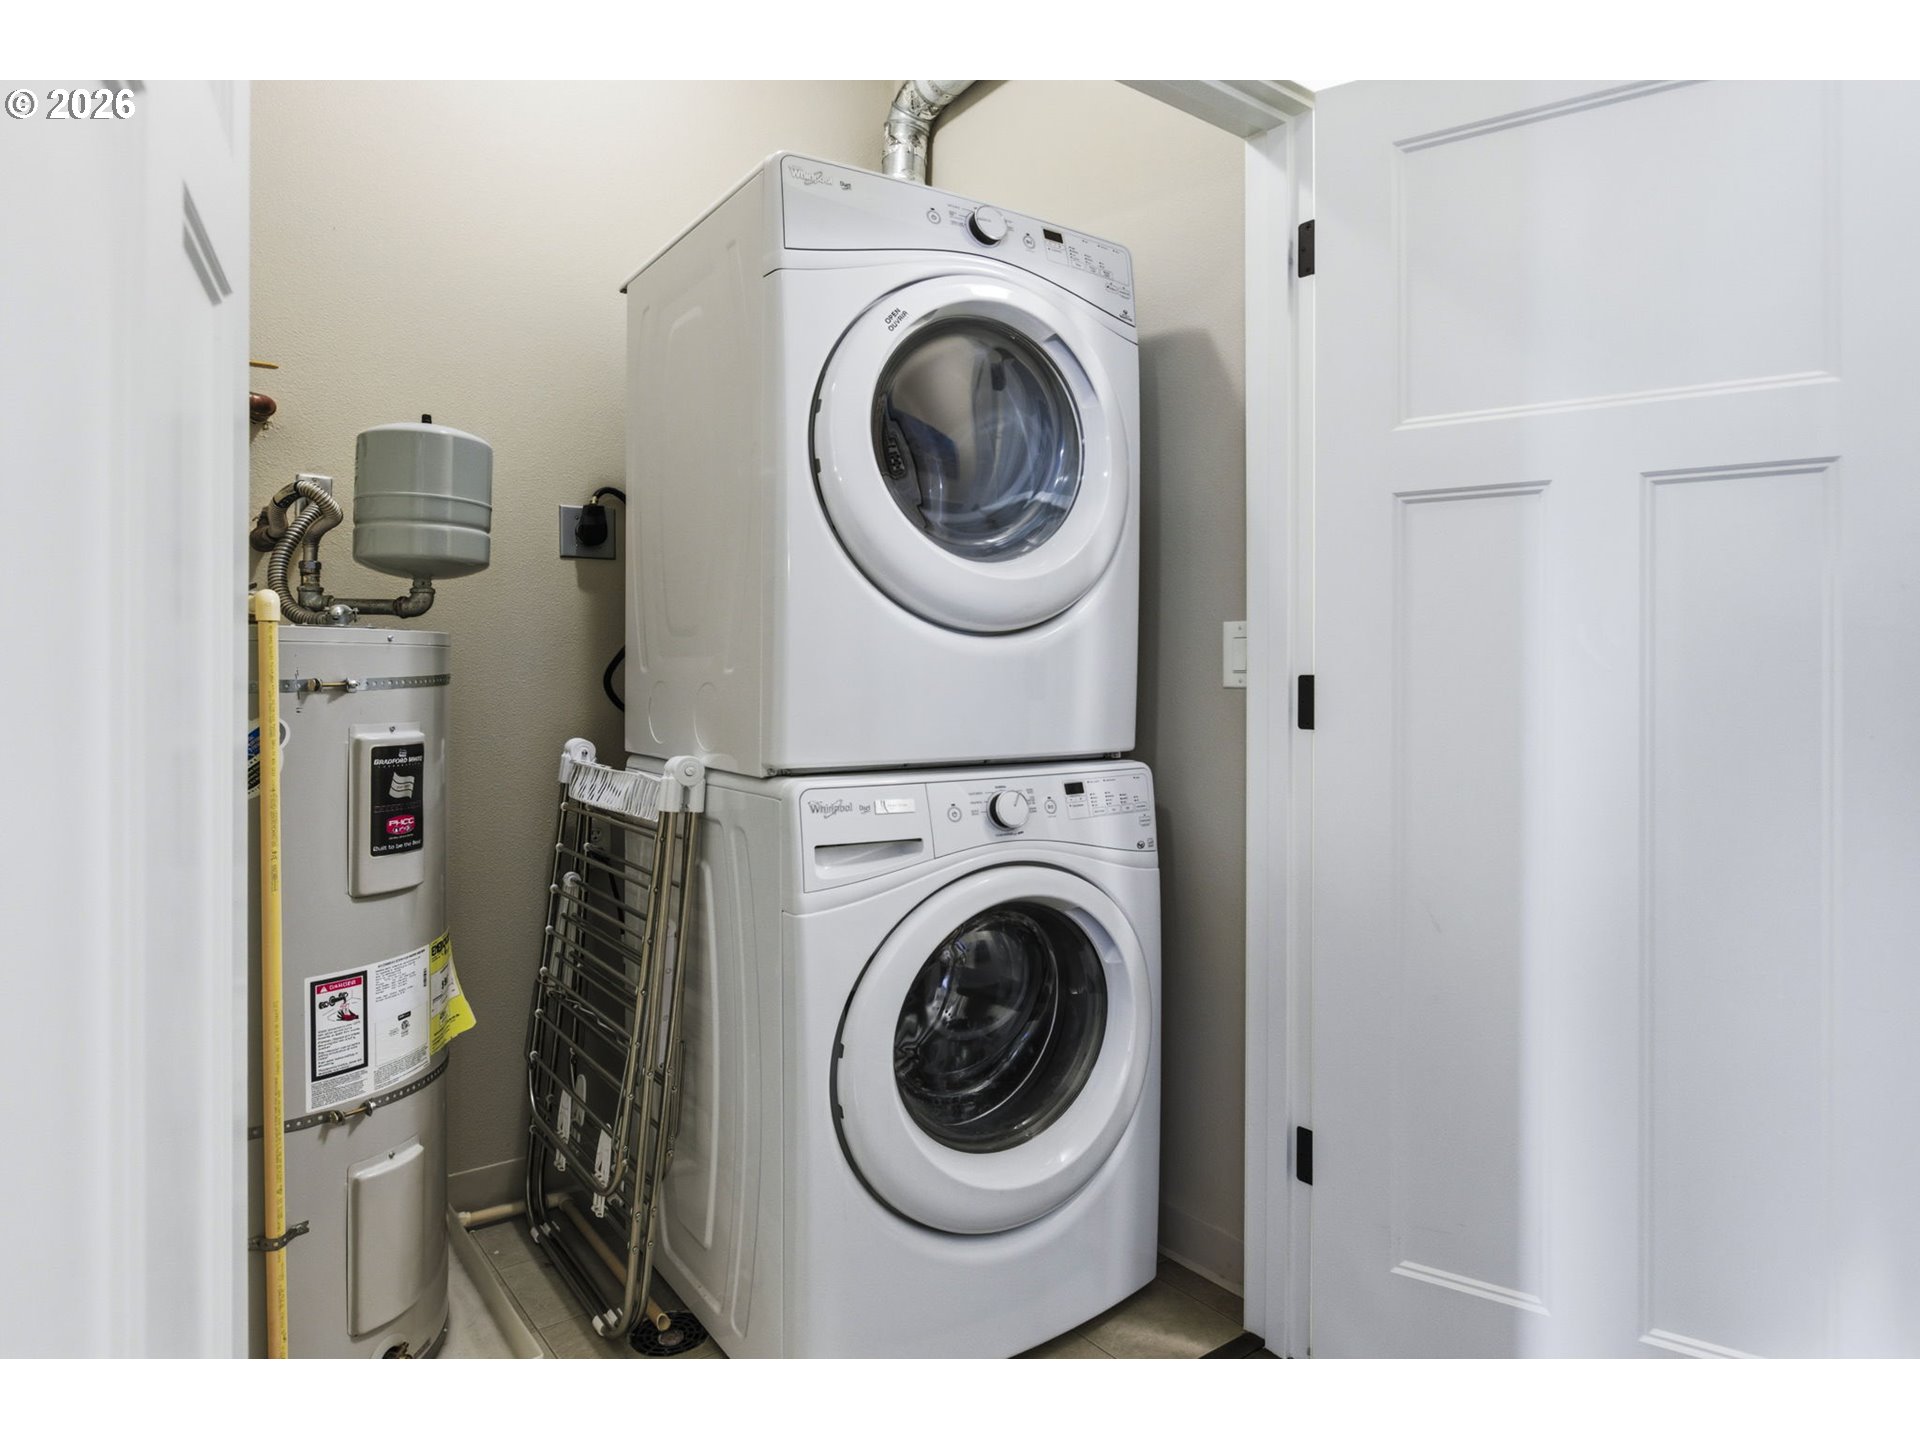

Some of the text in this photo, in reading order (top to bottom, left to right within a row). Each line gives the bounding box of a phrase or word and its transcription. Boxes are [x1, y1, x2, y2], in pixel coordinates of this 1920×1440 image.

[884, 307, 901, 324] OPEN
[808, 799, 853, 818] Whirlpool
[389, 816, 414, 826] PHCC
[329, 979, 357, 990] DANGER
